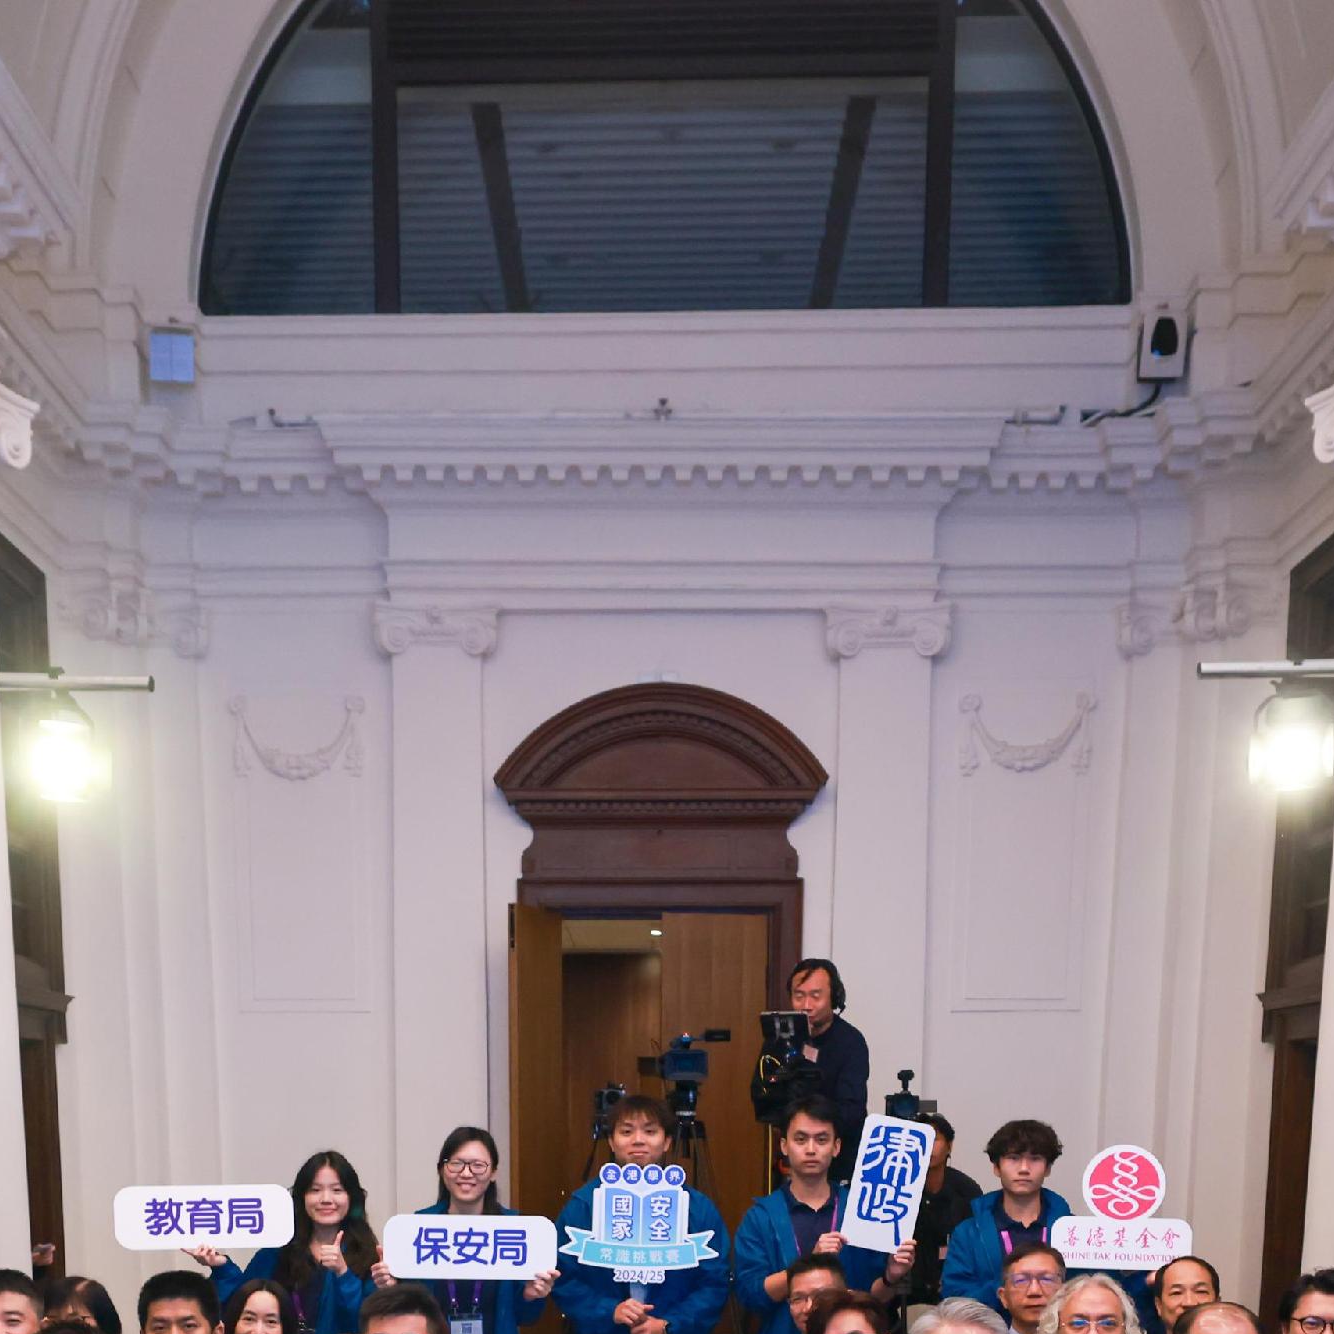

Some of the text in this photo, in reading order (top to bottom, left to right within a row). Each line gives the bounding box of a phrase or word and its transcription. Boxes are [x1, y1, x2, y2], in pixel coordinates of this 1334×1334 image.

[605, 1168, 681, 1184] 全港學界
[144, 1197, 265, 1236] 教育局
[612, 1194, 633, 1241] 國家
[649, 1194, 672, 1241] 安全
[412, 1226, 528, 1267] 保安局
[1063, 1225, 1182, 1249] 善德基金會
[599, 1248, 680, 1264] 常識挑戰賽
[1063, 1252, 1091, 1260] SHINE
[1094, 1252, 1110, 1260] TAK
[615, 1270, 665, 1283] 2024/25
